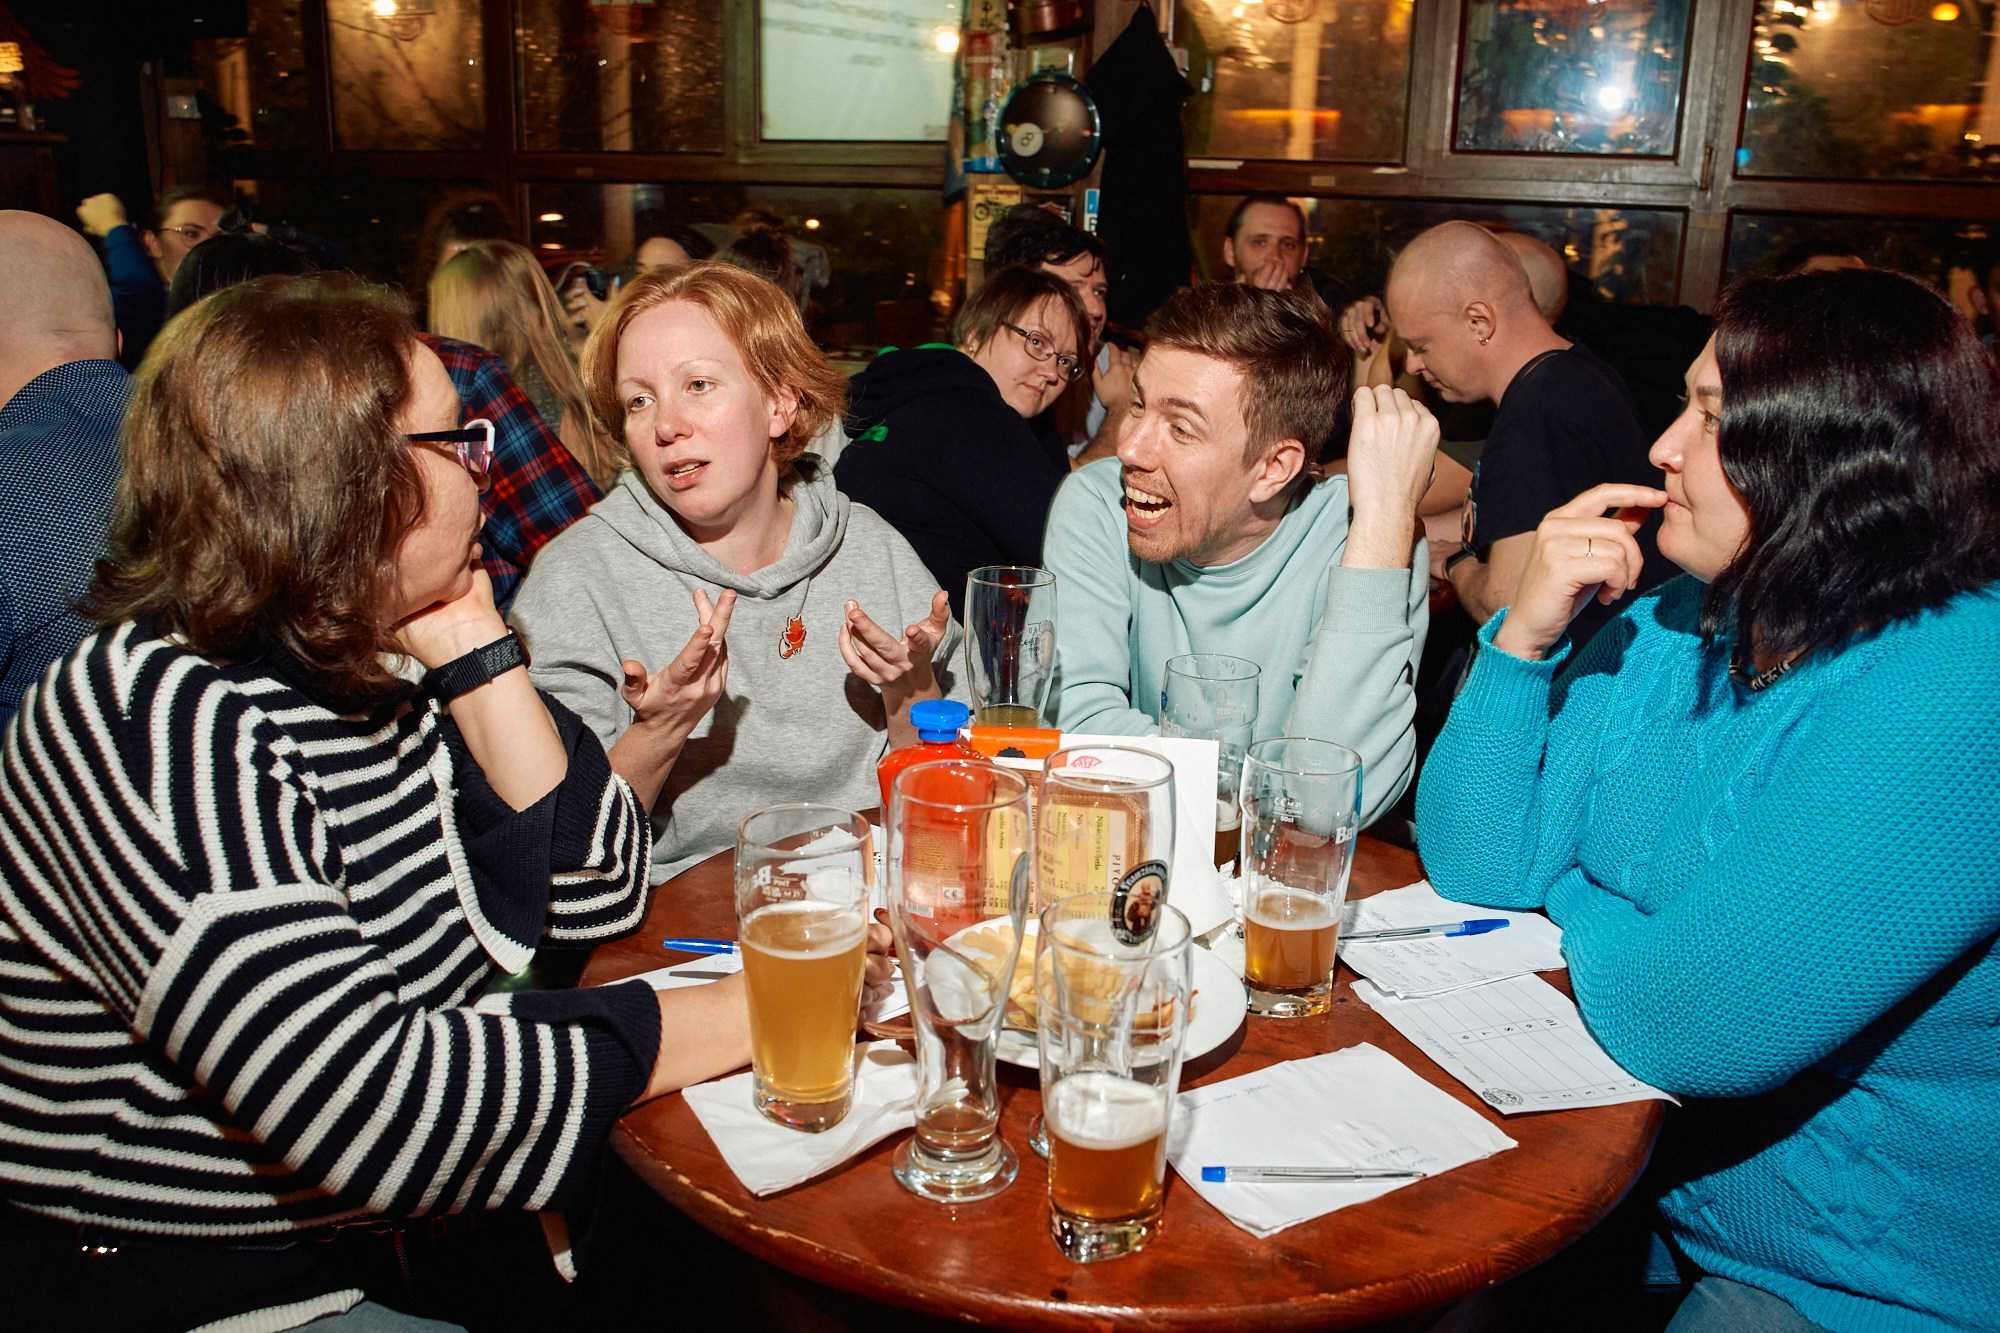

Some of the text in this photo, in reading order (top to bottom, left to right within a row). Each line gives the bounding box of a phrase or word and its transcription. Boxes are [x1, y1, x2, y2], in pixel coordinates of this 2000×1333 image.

[1020, 131, 1035, 147] 8
[1075, 758, 1099, 768] CITY
[1111, 854, 1121, 886] PIVO
